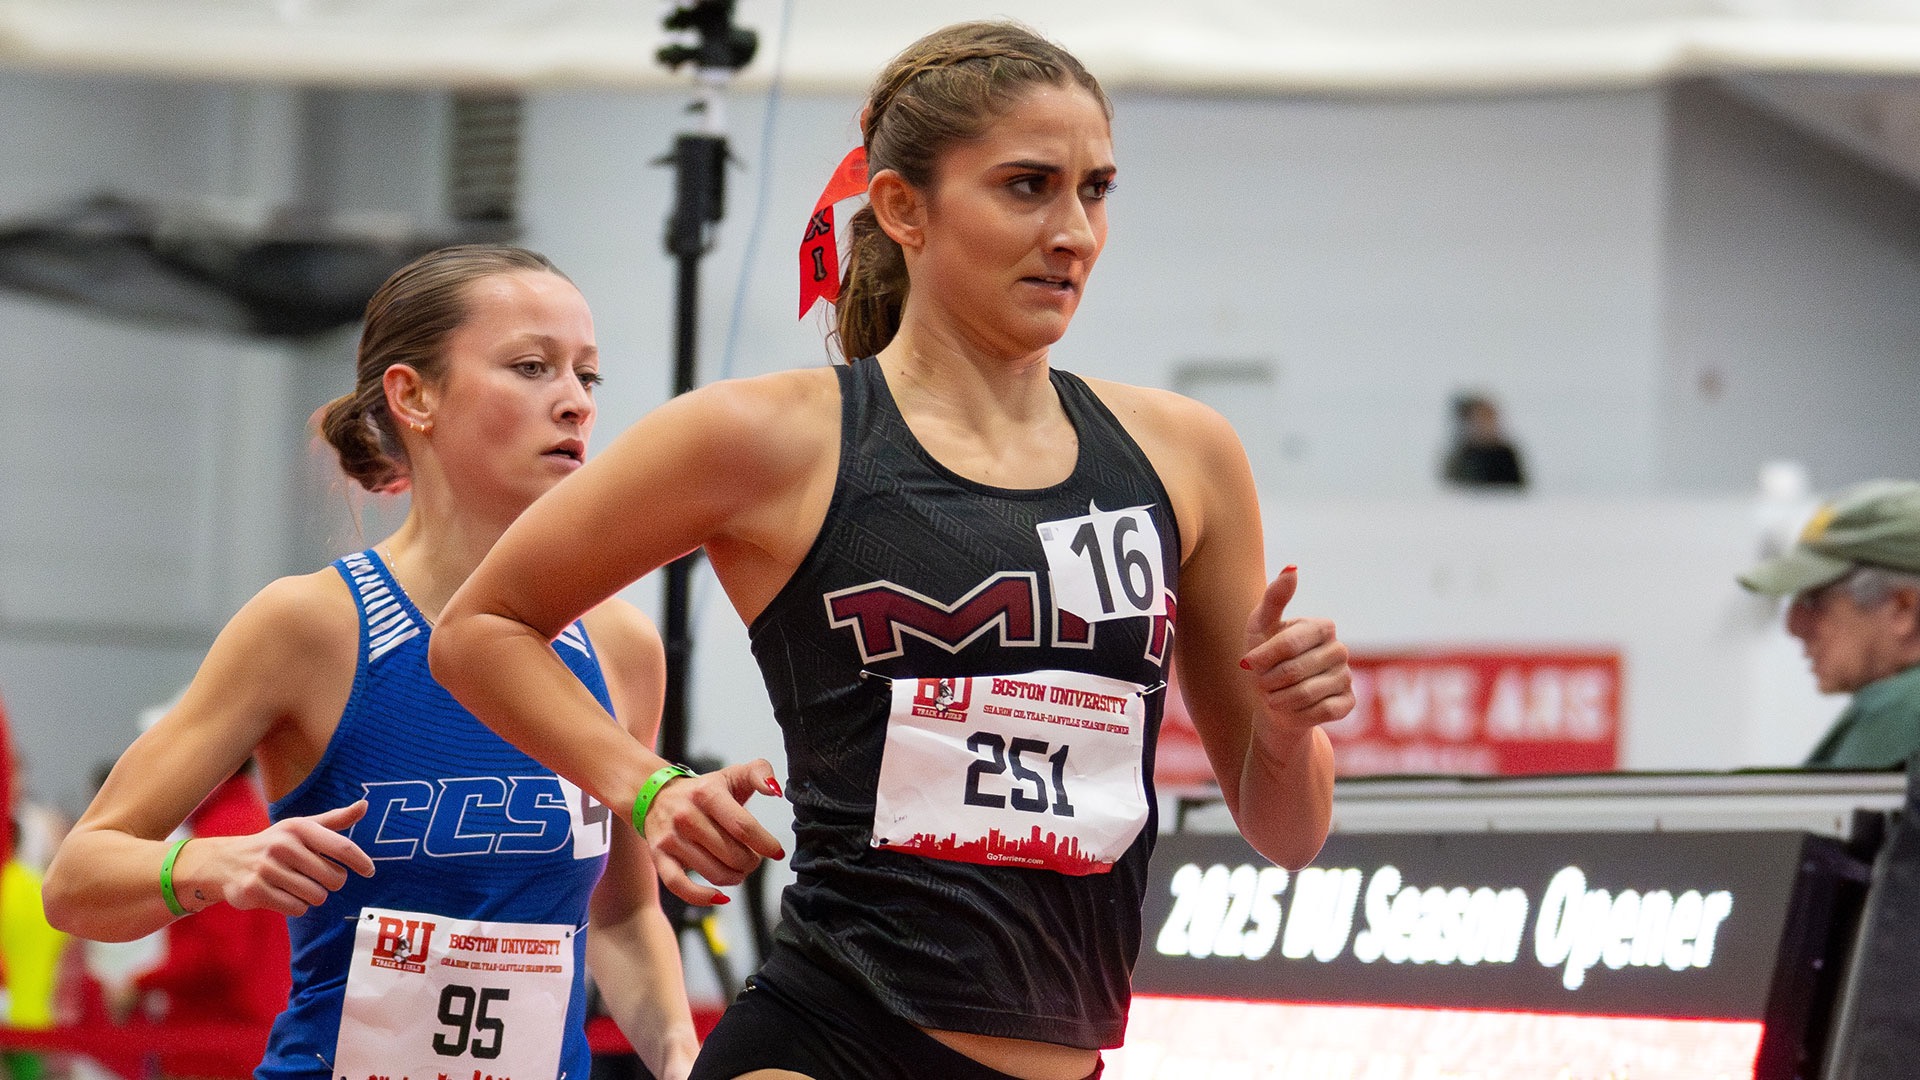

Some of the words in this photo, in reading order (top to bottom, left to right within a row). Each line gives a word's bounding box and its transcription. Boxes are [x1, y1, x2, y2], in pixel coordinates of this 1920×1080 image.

[1069, 515, 1154, 614] 16
[916, 707, 938, 718] TRACK
[991, 677, 1047, 702] BOSTON
[1049, 686, 1128, 715] UNIVERSITY
[1081, 719, 1106, 732] SEASON
[964, 731, 1075, 818] 251
[986, 852, 1044, 866] GoTerriers.com
[372, 916, 436, 963] BU
[449, 933, 499, 953] BOSTON
[501, 938, 561, 956] UNIVERSITY
[1156, 863, 1290, 961] 2025
[1353, 865, 1530, 966] Season
[1535, 865, 1733, 990] Opener
[432, 984, 510, 1060] 95
